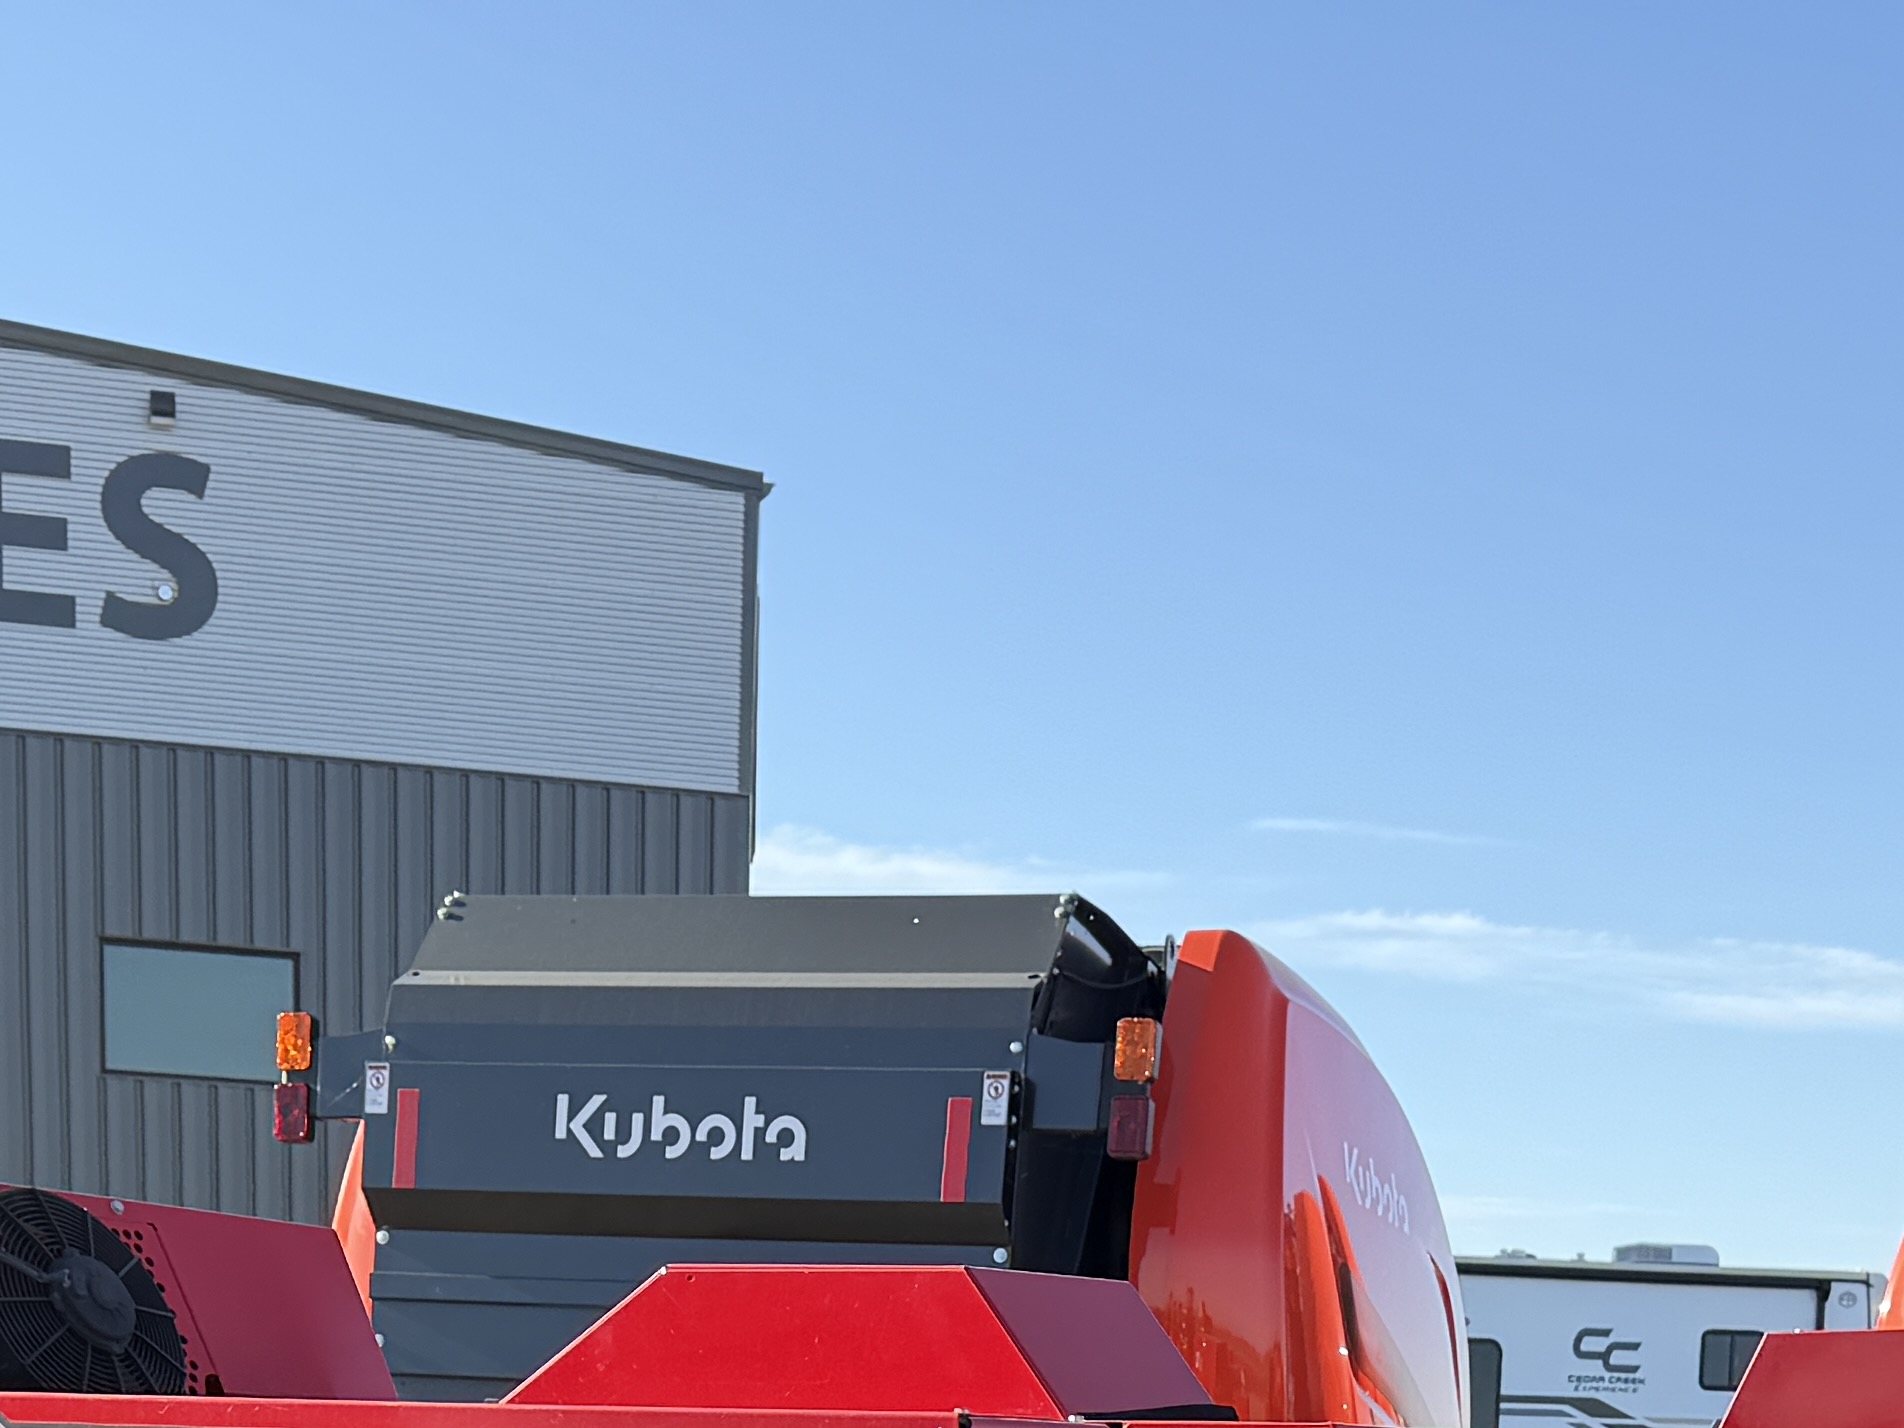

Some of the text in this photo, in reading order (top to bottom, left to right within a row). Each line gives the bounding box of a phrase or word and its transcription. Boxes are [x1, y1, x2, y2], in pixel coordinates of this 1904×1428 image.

[554, 1093, 807, 1161] Kubota
[1343, 1140, 1410, 1235] Kubota
[1567, 1374, 1646, 1385] CEDAR CREEK
